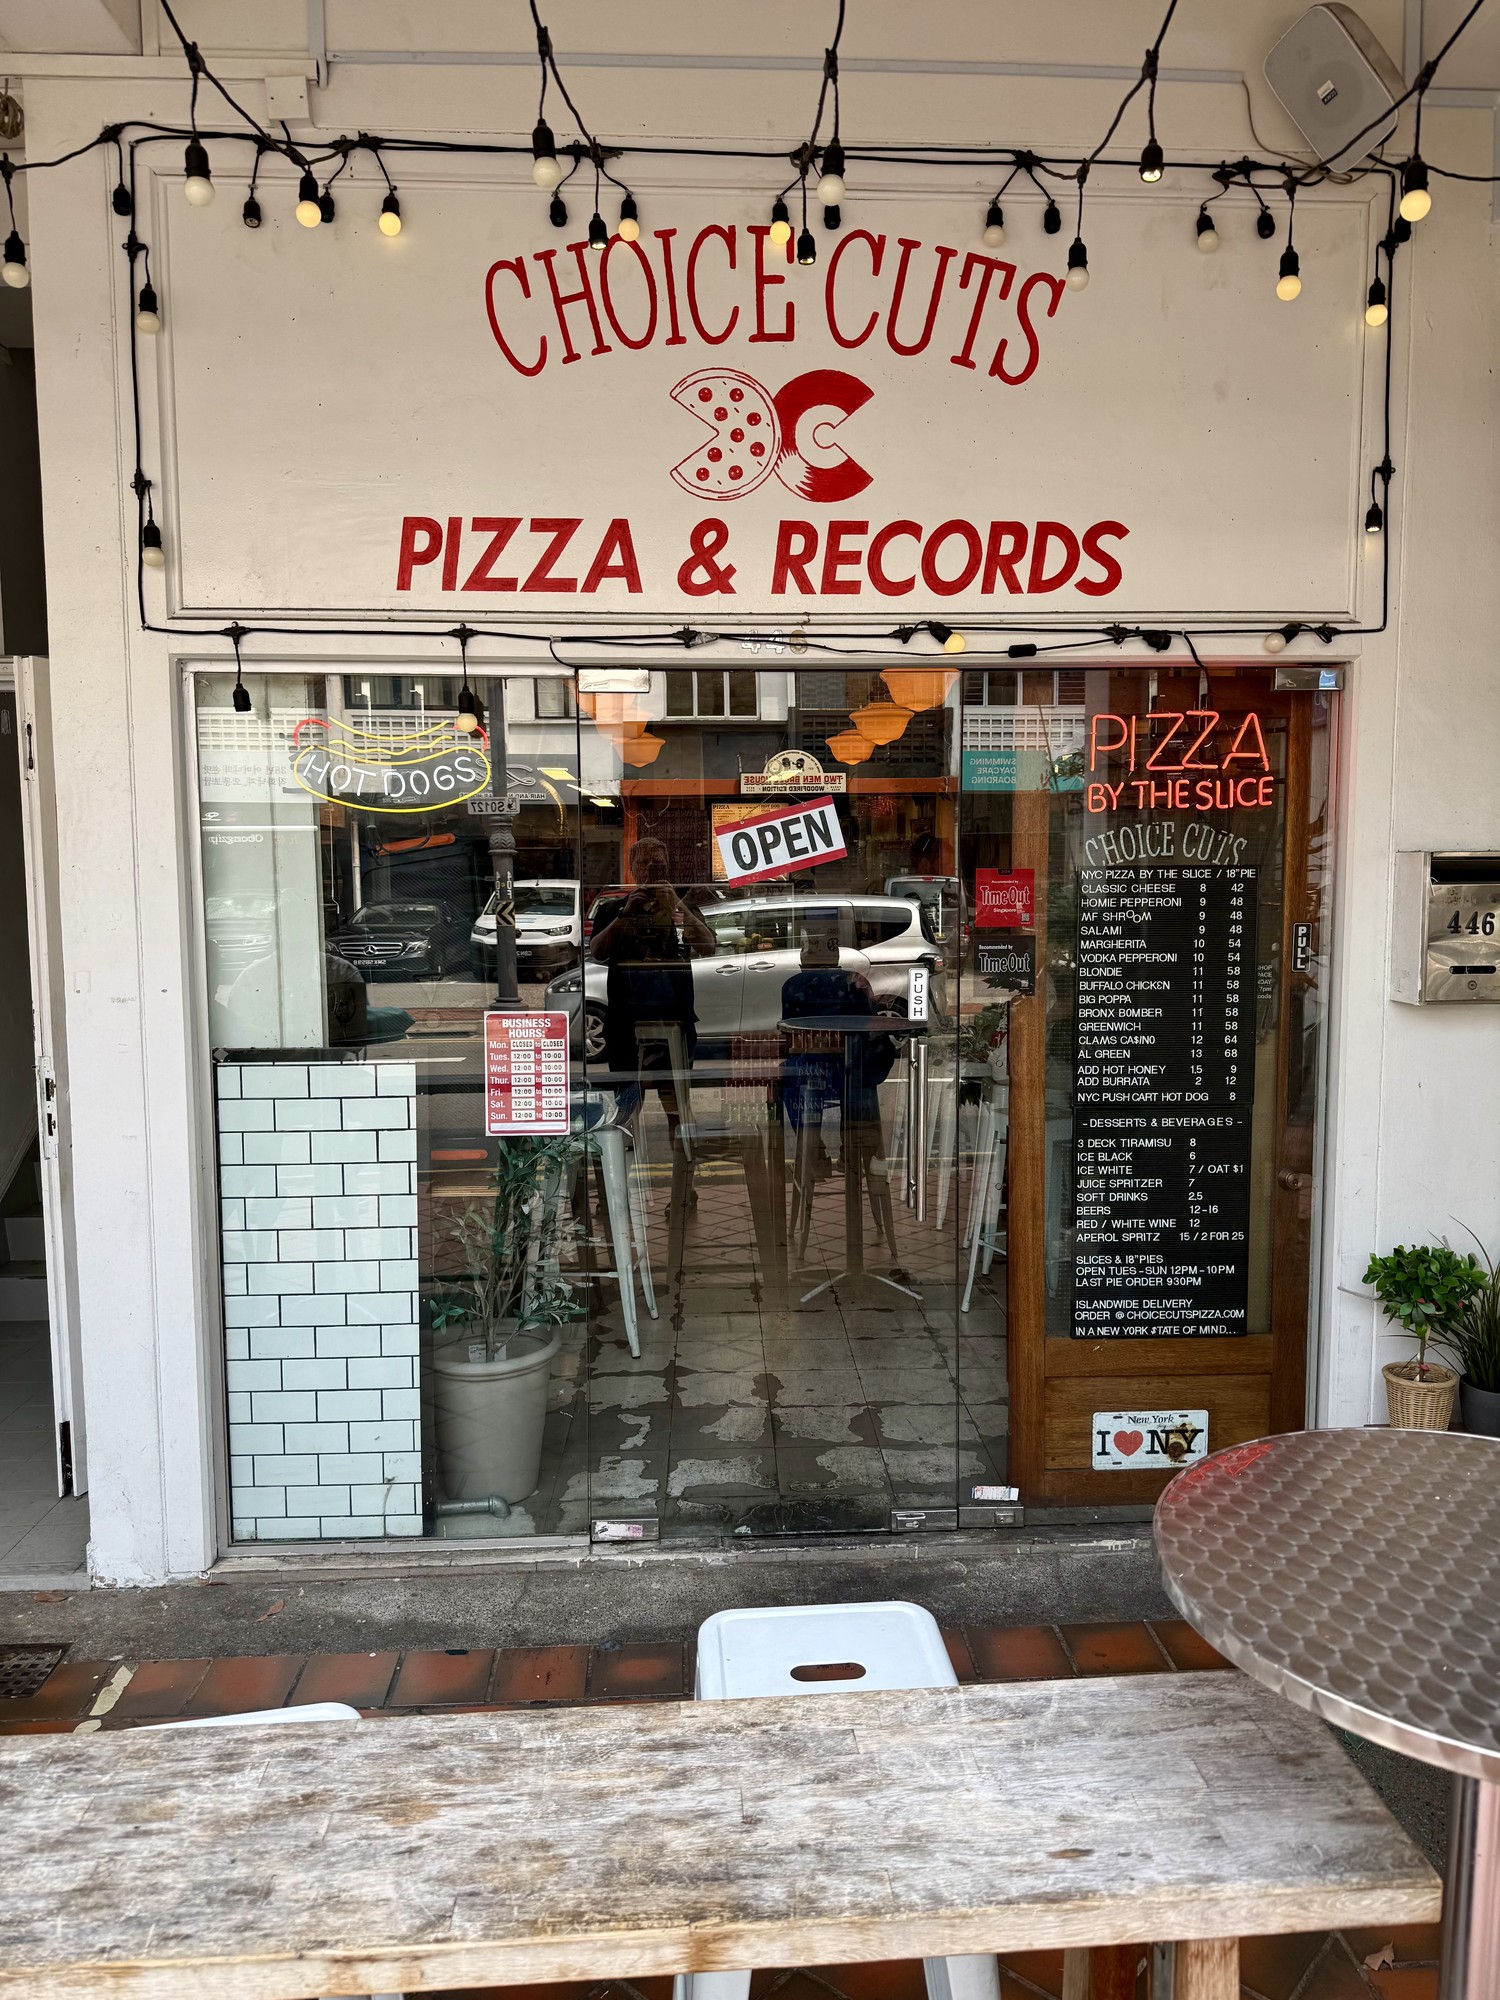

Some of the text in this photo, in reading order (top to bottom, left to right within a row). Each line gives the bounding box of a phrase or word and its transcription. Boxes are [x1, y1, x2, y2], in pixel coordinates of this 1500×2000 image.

[485, 224, 1067, 385] CHOICE CUTS
[396, 516, 1131, 596] PIZZA & RECORDS
[1090, 710, 1270, 771] PIZZA
[303, 754, 476, 798] HOT DOGS
[1088, 776, 1274, 813] BY THE SLICE
[732, 810, 834, 871] OPEN
[1084, 822, 1248, 866] CHOICE CUTS
[1082, 869, 1211, 880] NYC PIZZA BY THE SLICE
[1082, 883, 1243, 893] CLASSIC CHEESE 8 42
[980, 886, 1030, 905] Time Out
[1082, 898, 1243, 907] HOMIE PEPPERONI 9 48
[1082, 910, 1242, 923] MF SHROOM 9 48
[1447, 911, 1496, 935] 446
[1081, 925, 1242, 935] SALAMI 48
[1081, 939, 1241, 949] MARGHERITA 10 54
[1297, 926, 1307, 969] PULL
[979, 953, 1030, 972] Time Out
[1081, 953, 1240, 962] VODKA PEPPERONI 10 54
[1080, 967, 1240, 976] BLONDIE 11 58
[1080, 980, 1239, 990] BUFFALO 11 58
[913, 972, 923, 1016] PUSH
[1079, 994, 1239, 1004] BIG POPPA 11 58
[1079, 1008, 1238, 1017] BRONX 11 58
[502, 1019, 551, 1028] BUSINESS
[1079, 1022, 1238, 1031] GREENWICH 11 58
[509, 1029, 545, 1038] HOURS:
[490, 1041, 508, 1049] Mon.
[1079, 1035, 1237, 1045] CLAMS 12 64
[1078, 1049, 1237, 1058] AL GREEN 13 68
[1078, 1065, 1202, 1074] ADD HOT HONEY 1.5
[1077, 1077, 1099, 1086] ADD
[1103, 1077, 1150, 1086] BURRATA
[1078, 1093, 1208, 1102] NYC HOT DOG
[1090, 1118, 1233, 1127] DESSERTS BEVERAGES
[1088, 1139, 1171, 1147] DECK TIRAMISU
[1078, 1152, 1132, 1161] ICE BLACK
[1078, 1165, 1243, 1175] ICE WHITE OAT $1
[1077, 1179, 1162, 1188] JUICE SPRITZER
[1077, 1192, 1202, 1201] SOFT DRINKS 2.5
[1077, 1206, 1111, 1215] BEERS
[1077, 1219, 1200, 1229] RED WHITE WINE 12
[1076, 1233, 1118, 1242] APEROL
[1122, 1233, 1160, 1241] SPRITZ
[1232, 1232, 1244, 1240] 25
[1076, 1256, 1112, 1264] SLICES
[1076, 1267, 1105, 1275] OPEN
[1076, 1277, 1201, 1286] LAST PIE ORDER 930PM
[1076, 1299, 1192, 1309] ISLANDWIDE DELIVERY
[1075, 1311, 1110, 1320] ORDER
[1076, 1327, 1085, 1335] IN
[1097, 1327, 1120, 1335] NEW
[1183, 1326, 1197, 1334] OF
[1127, 1414, 1174, 1424] New York
[1097, 1429, 1204, 1456] I NY
